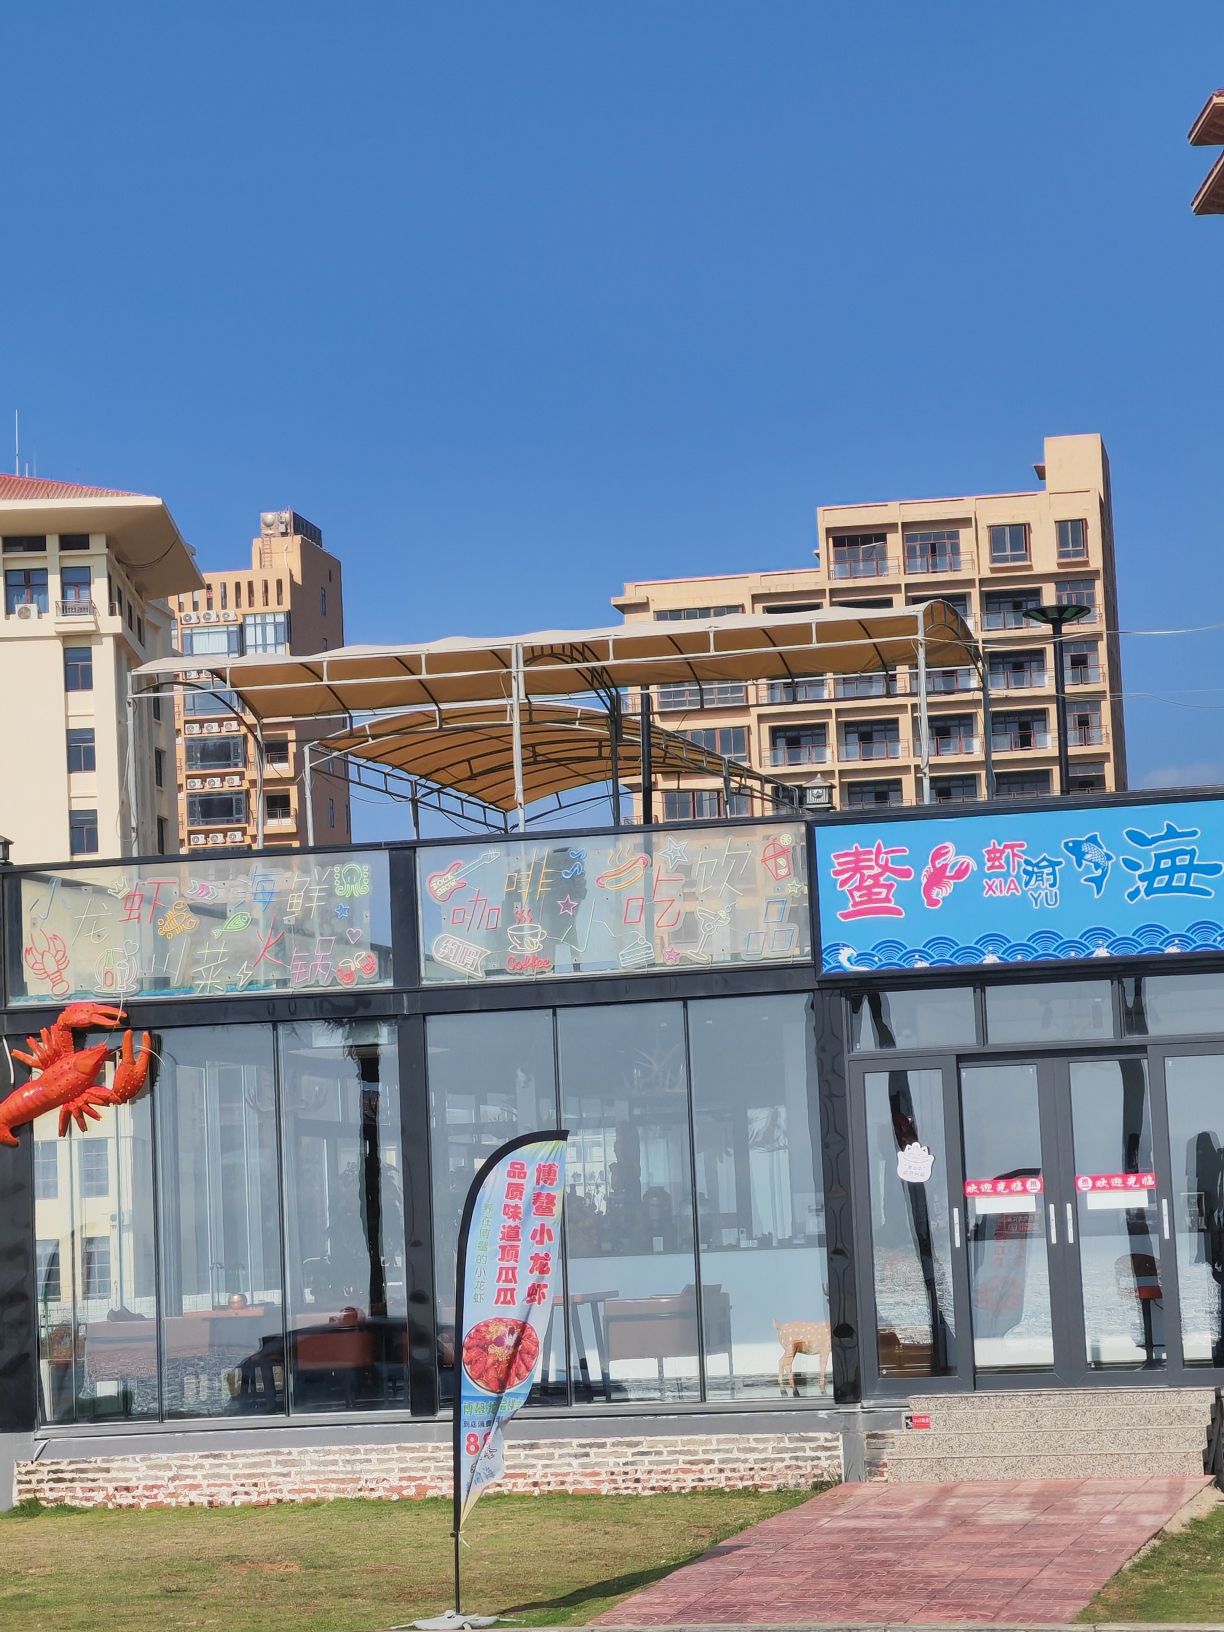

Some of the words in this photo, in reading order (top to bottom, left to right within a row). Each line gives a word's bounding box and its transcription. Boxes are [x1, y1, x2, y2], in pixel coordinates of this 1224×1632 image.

[233, 865, 333, 921] 海鲜
[437, 880, 459, 897] SHOW
[451, 848, 555, 933] 咖啡
[695, 837, 796, 956] 饮品
[983, 877, 1022, 897] XIA
[1028, 890, 1060, 909] YU
[253, 911, 337, 985] 火锅
[506, 955, 551, 971] Coffee
[965, 1180, 1024, 1194] 欢迎光临
[1095, 1175, 1156, 1190] 欢迎光临
[493, 1160, 528, 1306] 品质味道顶瓜瓜
[525, 1161, 560, 1306] 博鳌小龙虾
